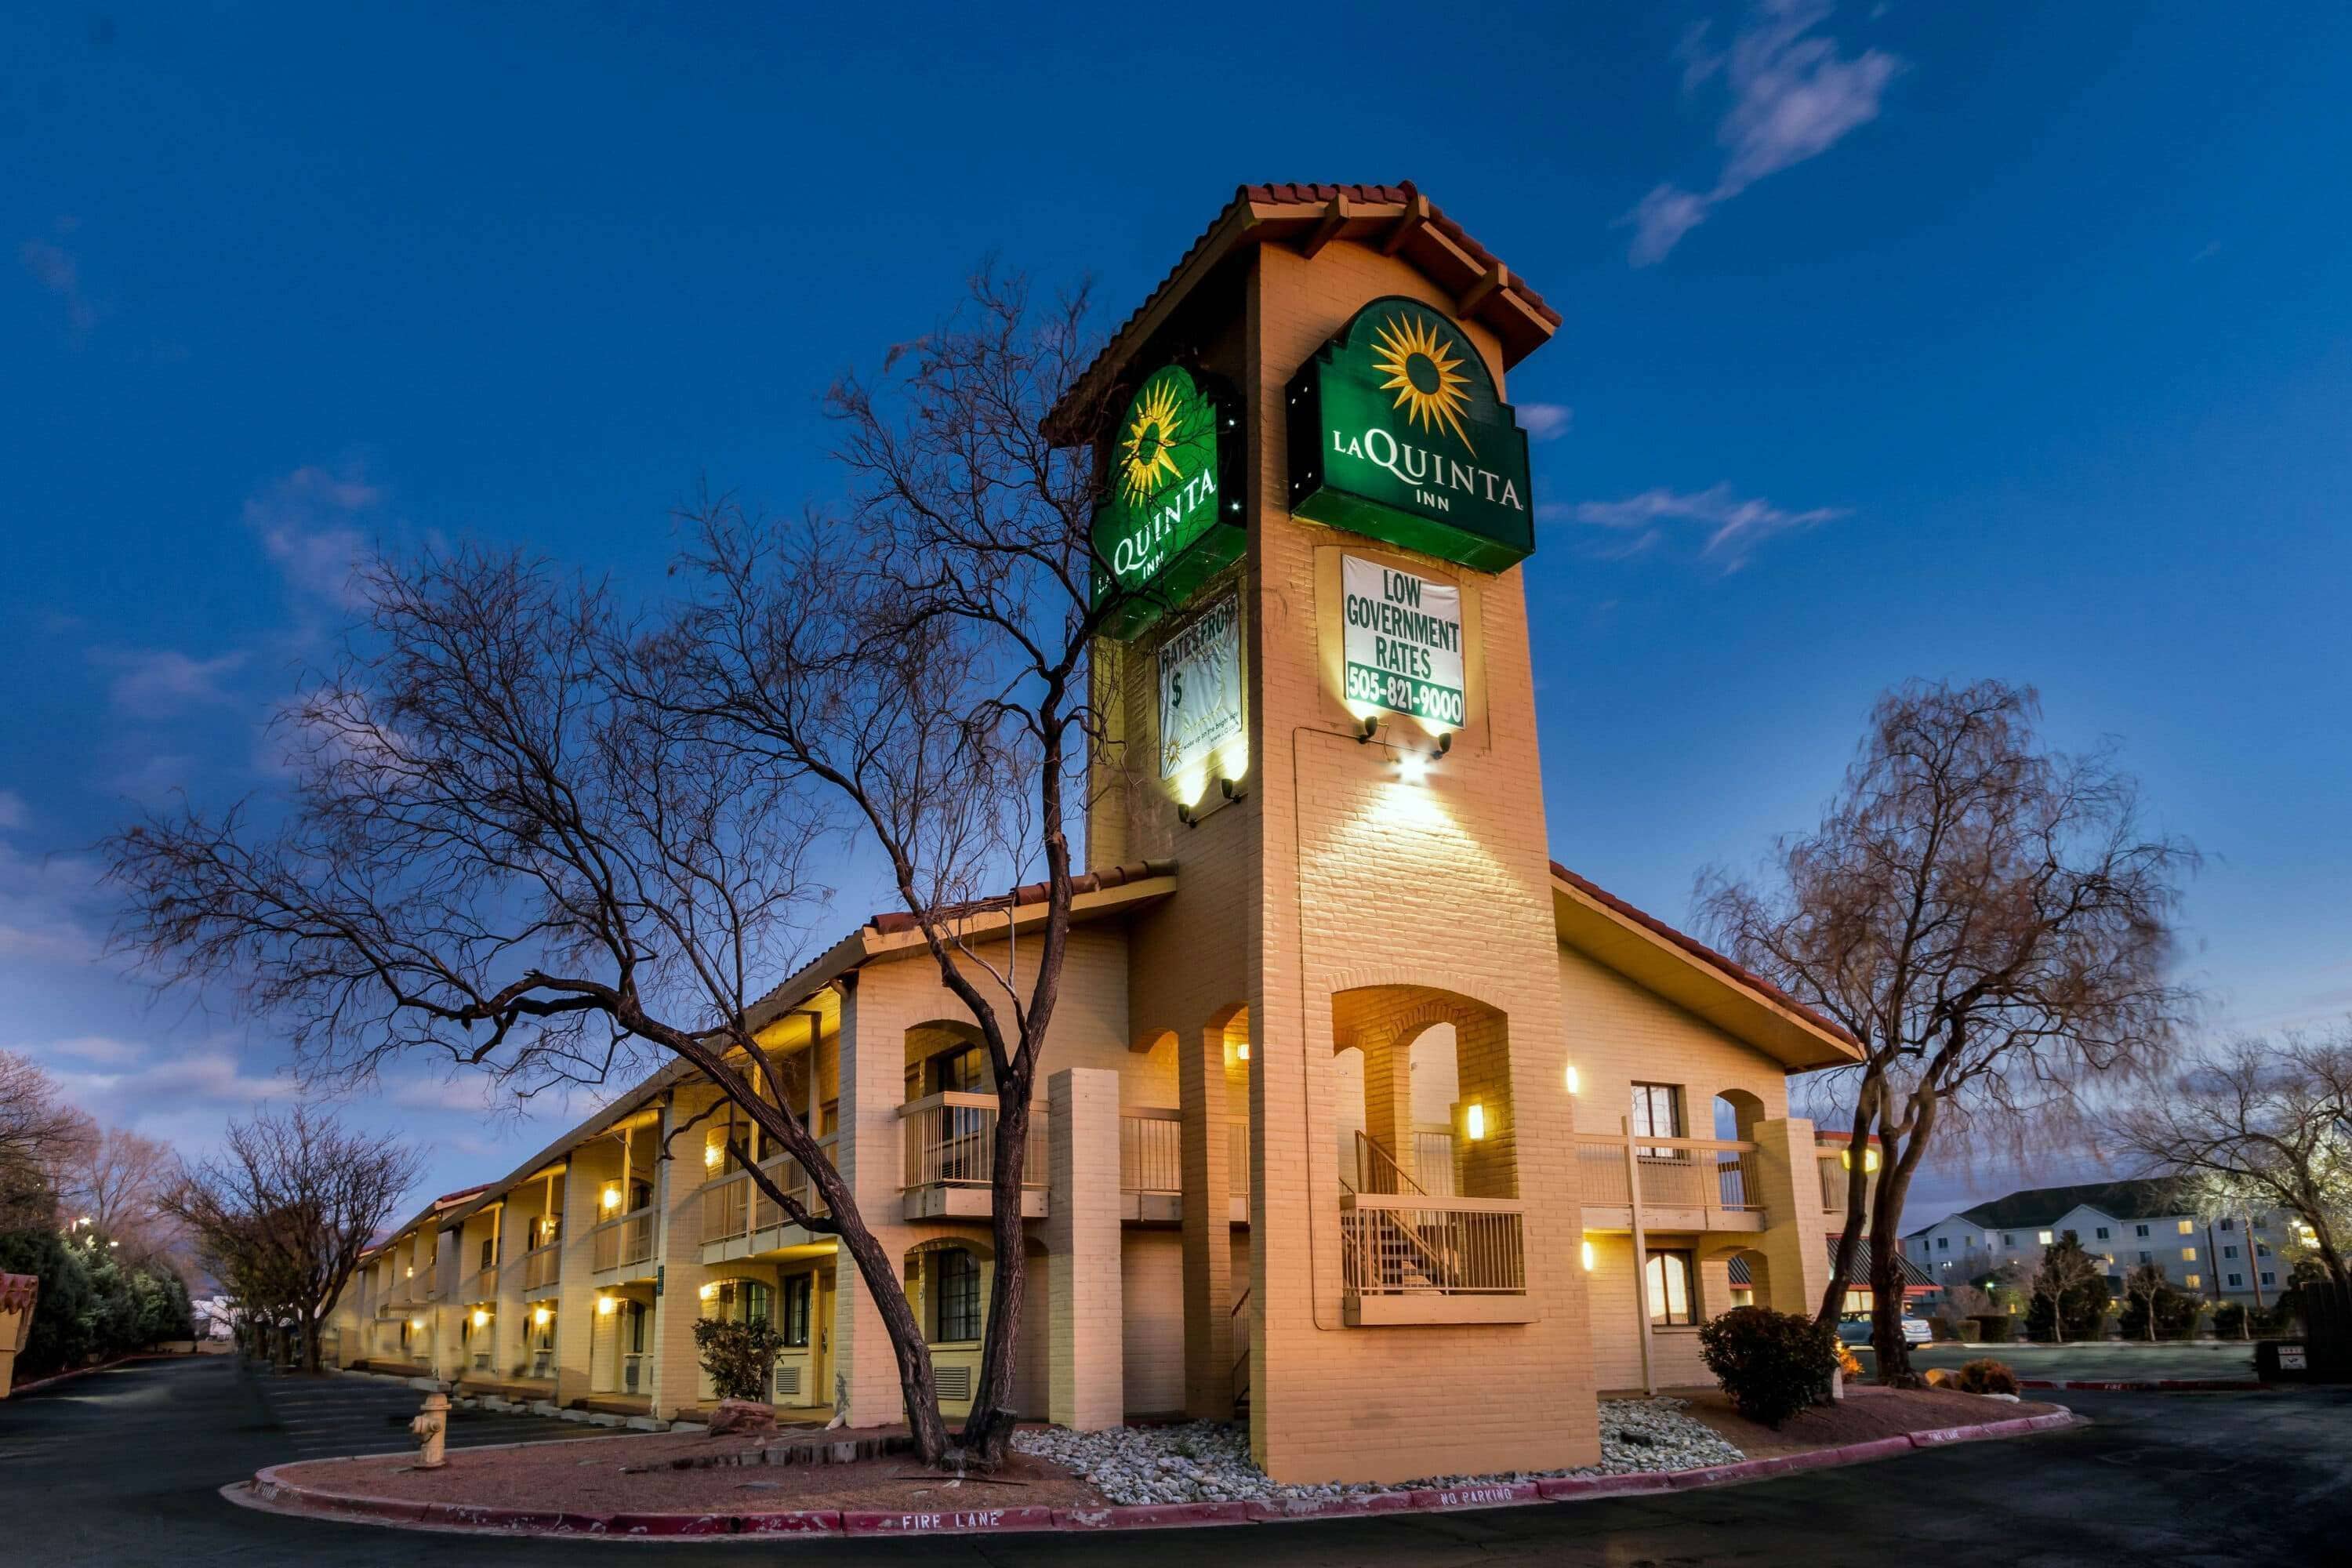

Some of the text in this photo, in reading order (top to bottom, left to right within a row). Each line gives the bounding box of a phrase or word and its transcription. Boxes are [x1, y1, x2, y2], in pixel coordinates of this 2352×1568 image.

[1333, 429, 1523, 510] LA QUINTA
[1416, 488, 1449, 511] INN
[1113, 468, 1216, 575] QUINTA
[1142, 551, 1163, 579] INN
[1383, 569, 1421, 609] LOW
[1347, 593, 1460, 653] GOVERNMENT
[1375, 636, 1432, 680] RATES
[1171, 672, 1182, 710] $
[1348, 666, 1463, 724] 505-821-9000
[1440, 1492, 1457, 1506] NO
[902, 1512, 1000, 1530] FIRE LANE
